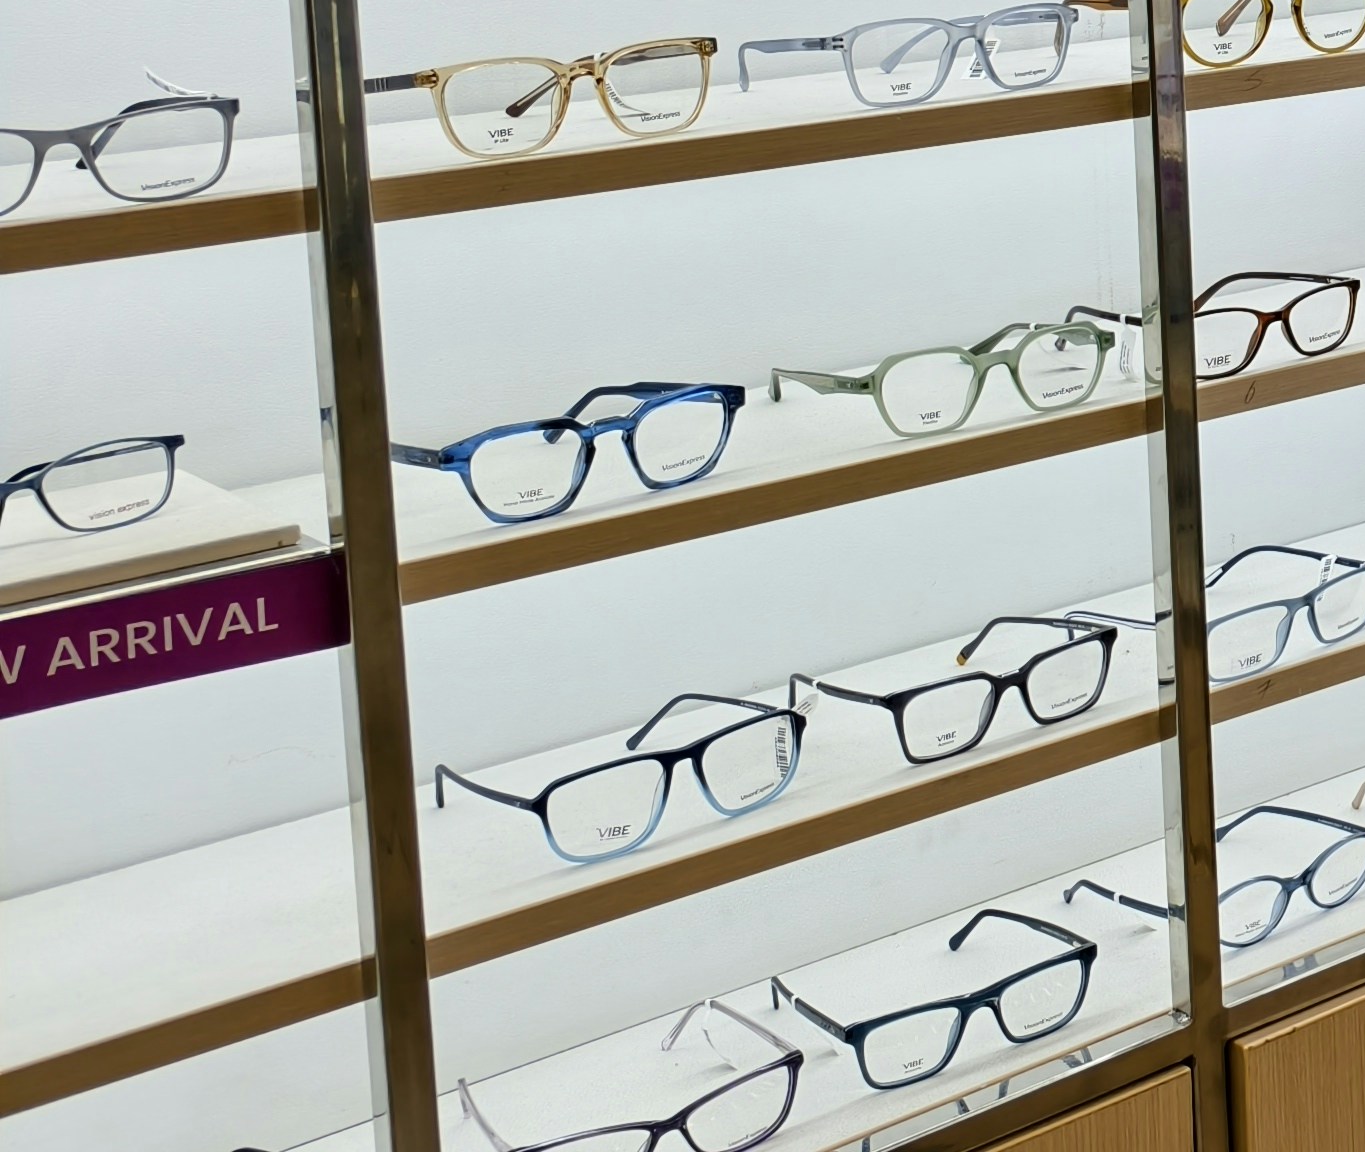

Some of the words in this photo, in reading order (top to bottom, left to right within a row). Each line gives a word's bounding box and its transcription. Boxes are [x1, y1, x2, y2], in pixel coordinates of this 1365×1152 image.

[1214, 43, 1232, 51] VIBE
[890, 83, 912, 92] VIBE
[641, 111, 681, 122] VisionExpress
[488, 128, 514, 139] VIBE
[1205, 355, 1231, 367] VIBE
[1042, 384, 1083, 399] VisionExpress
[919, 411, 941, 420] VIBE
[662, 454, 705, 471] VisionExpress
[518, 488, 543, 499] VIBE
[89, 509, 116, 521] vision
[118, 499, 150, 513] express
[47, 597, 279, 676] ARRIVAL
[1238, 654, 1262, 668] VIBE
[936, 731, 956, 741] VIBE
[596, 825, 631, 839] VIBE
